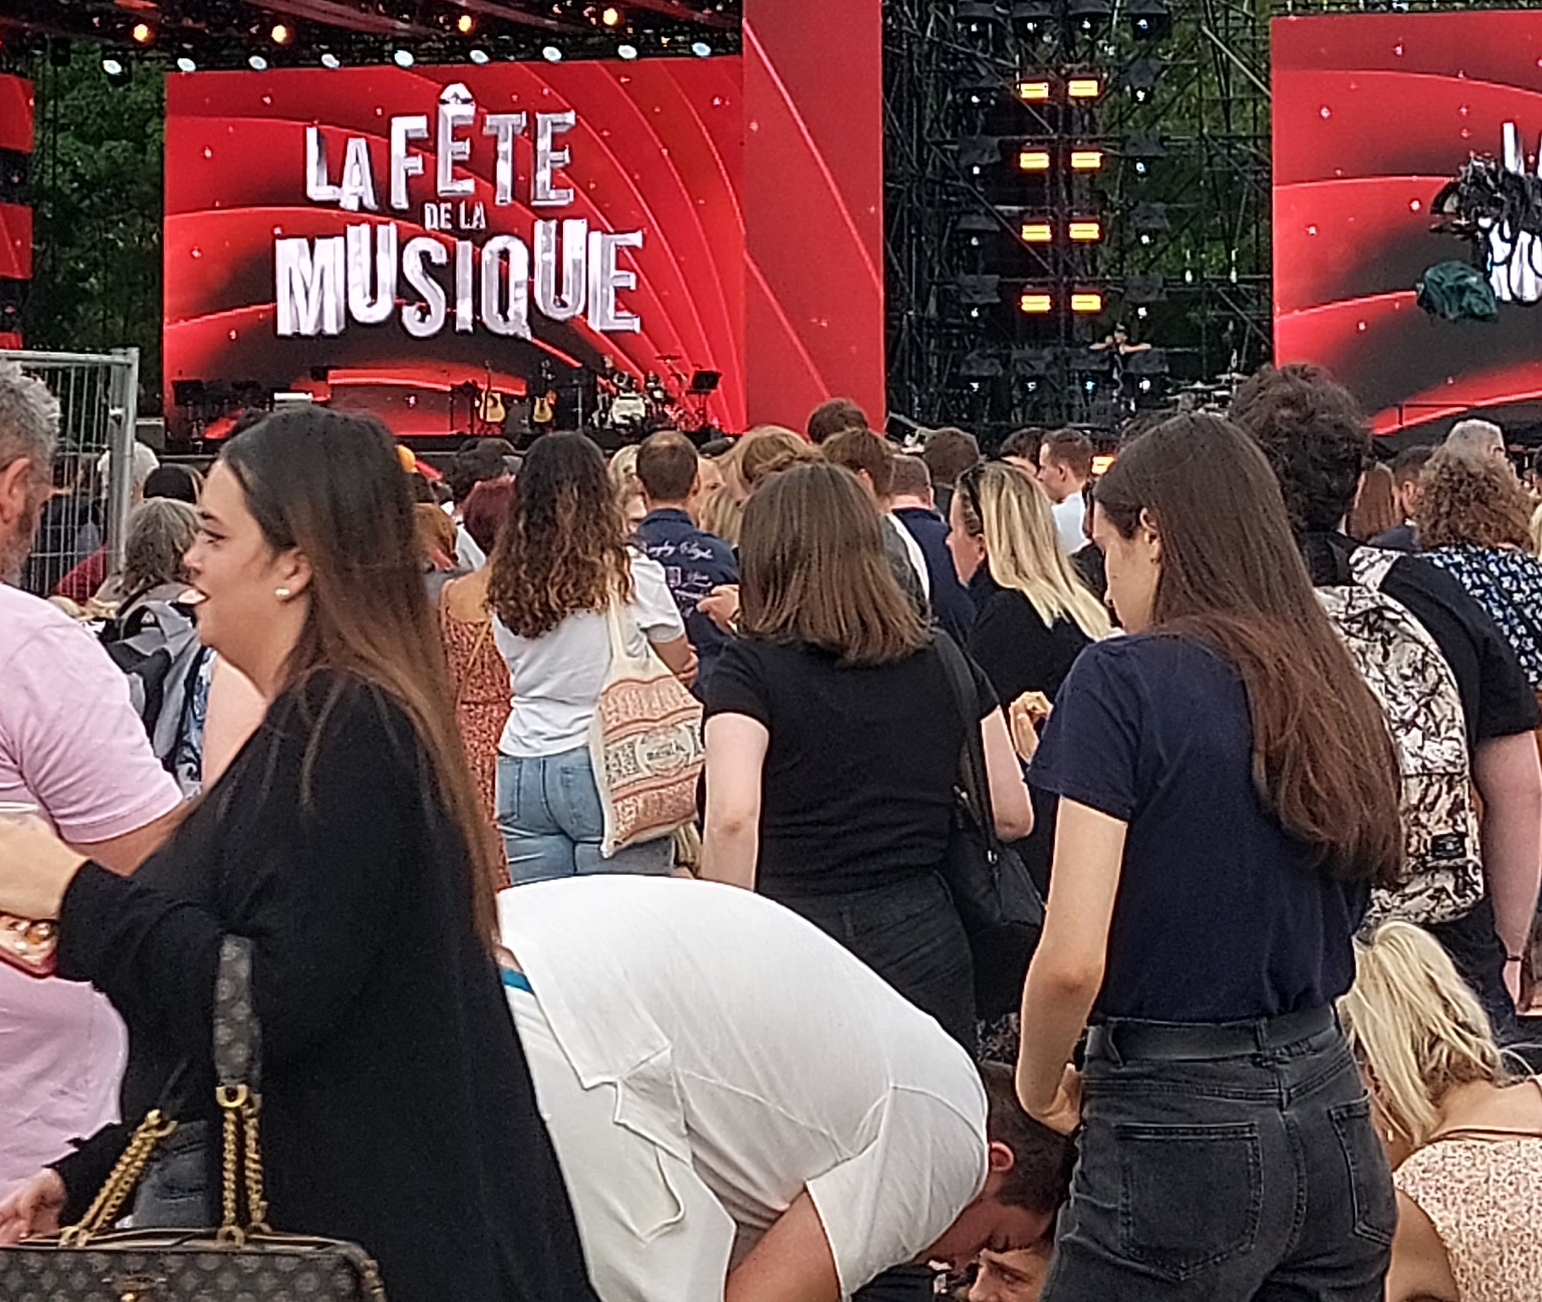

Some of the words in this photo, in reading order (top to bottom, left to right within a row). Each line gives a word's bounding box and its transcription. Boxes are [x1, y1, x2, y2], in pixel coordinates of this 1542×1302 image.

[304, 125, 377, 211] LA
[390, 82, 576, 210] FÊTE
[424, 202, 452, 231] DE
[459, 200, 486, 230] LA
[275, 219, 643, 339] MUSIQUE
